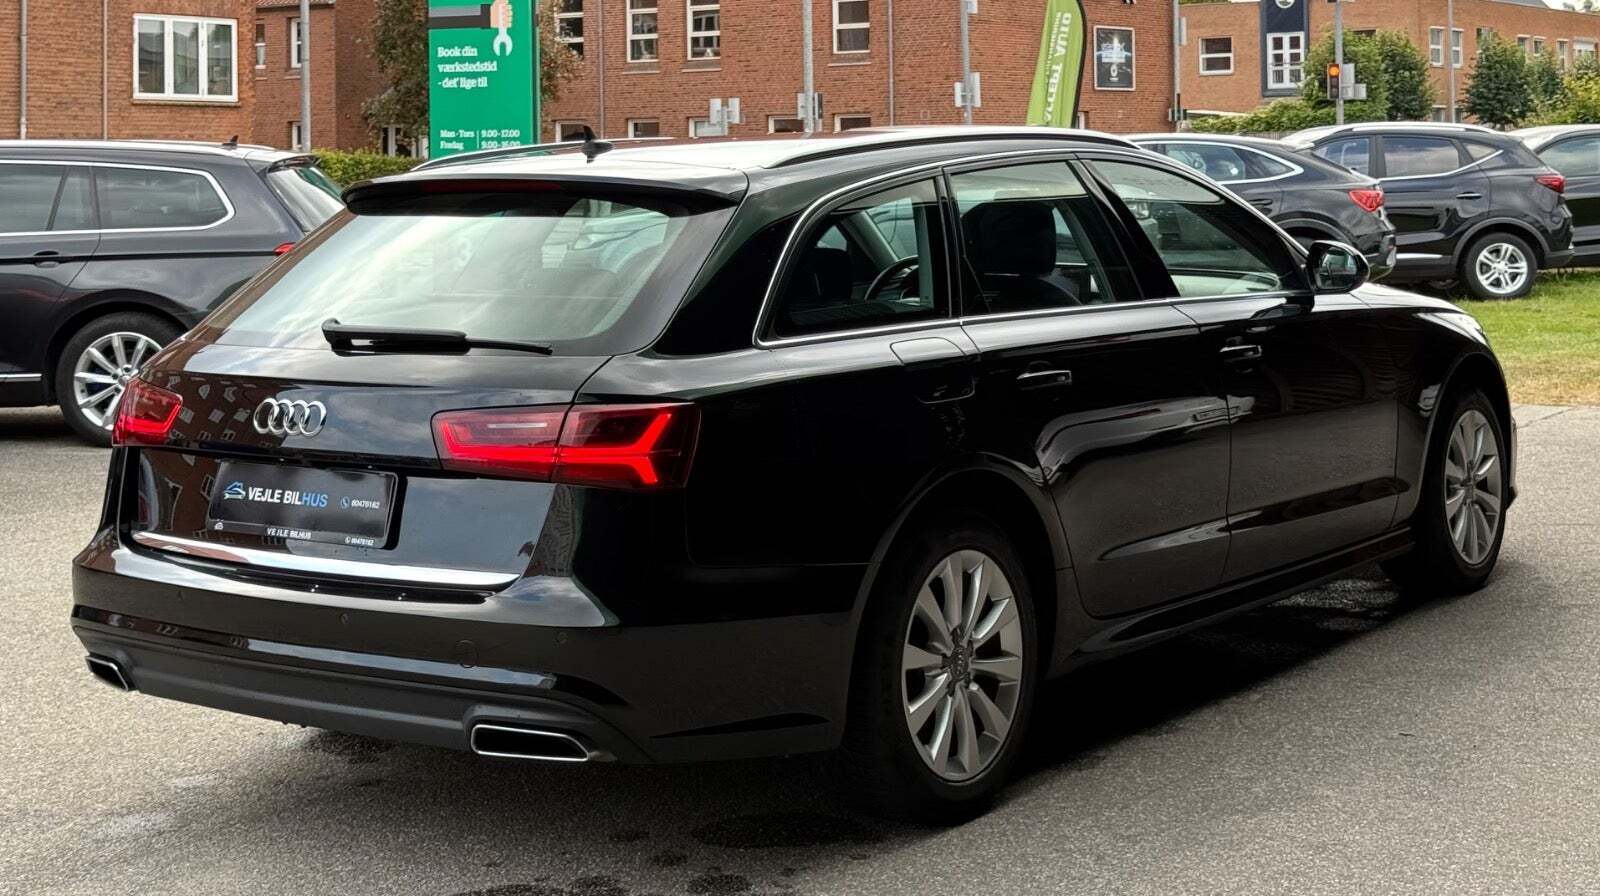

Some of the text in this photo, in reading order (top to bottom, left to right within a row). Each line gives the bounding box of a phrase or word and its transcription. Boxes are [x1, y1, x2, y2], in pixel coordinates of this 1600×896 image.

[437, 46, 478, 58] Book din
[437, 61, 498, 73] værkstedstid
[459, 77, 477, 90] lige
[477, 77, 488, 88] til
[440, 141, 464, 150] Fredag
[248, 487, 281, 504] VEJLE
[283, 490, 329, 508] BILHUS
